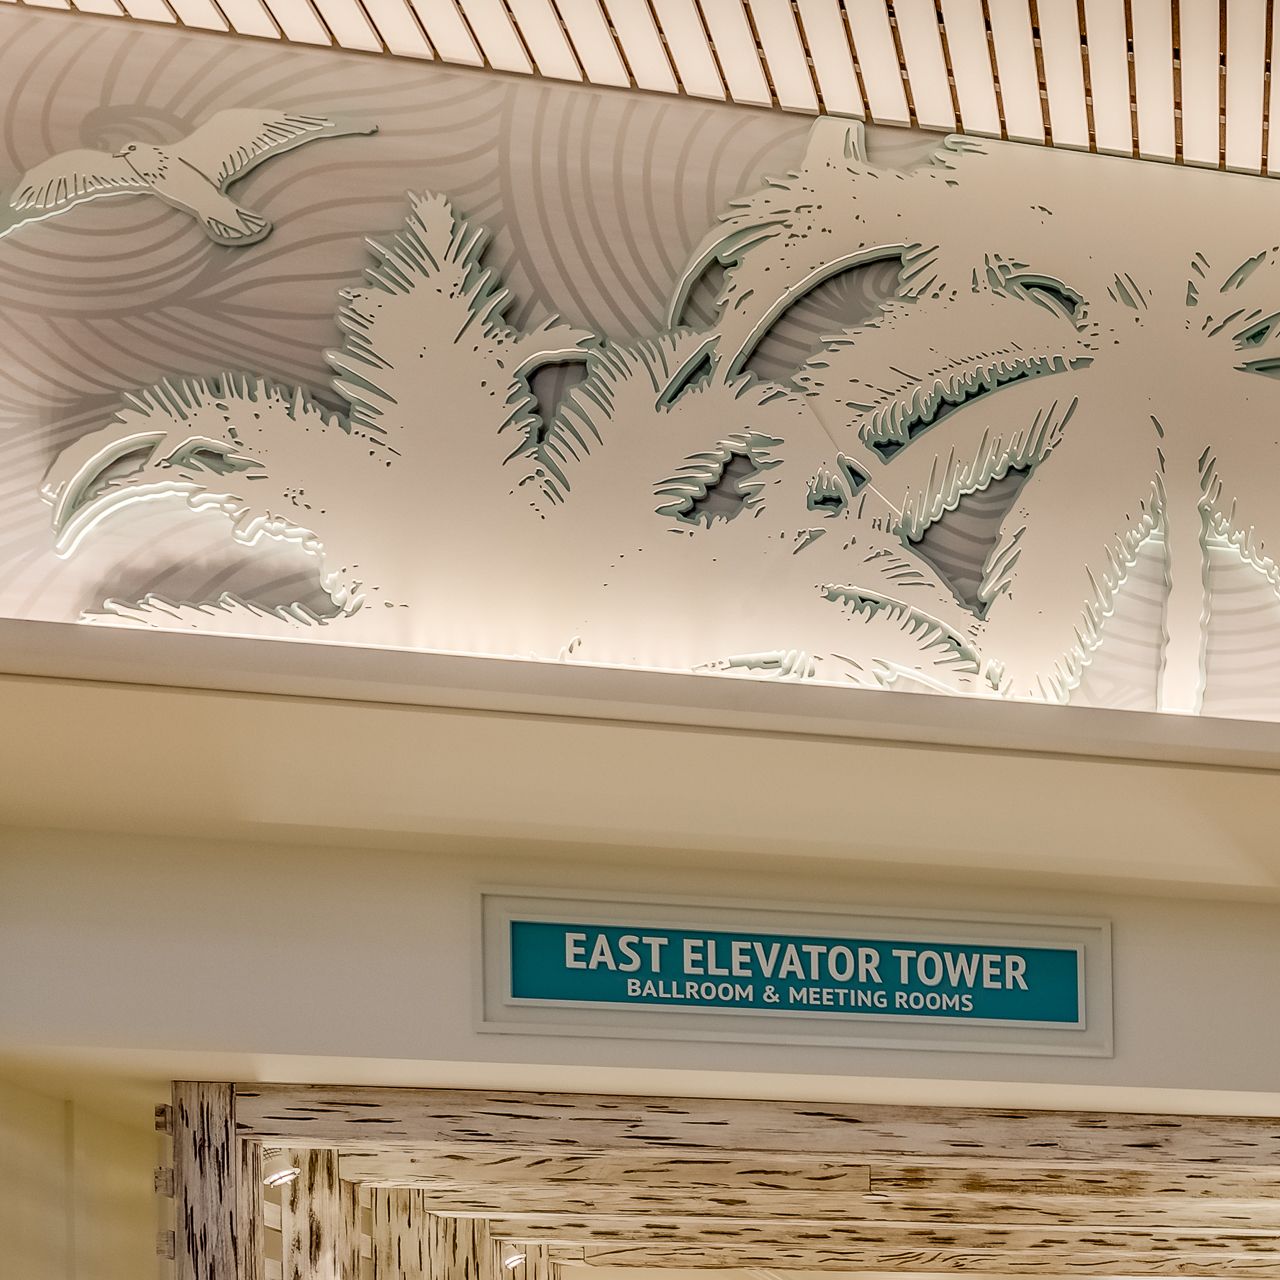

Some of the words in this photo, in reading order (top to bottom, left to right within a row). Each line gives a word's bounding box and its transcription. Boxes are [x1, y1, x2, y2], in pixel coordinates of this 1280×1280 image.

[565, 932, 668, 973] EAST
[683, 939, 883, 984] ELEVATOR
[892, 949, 1029, 991] TOWER
[627, 978, 754, 1002] BALLROOM
[762, 985, 780, 1003] &
[789, 986, 888, 1009] MEETING
[895, 991, 974, 1012] ROOMS
